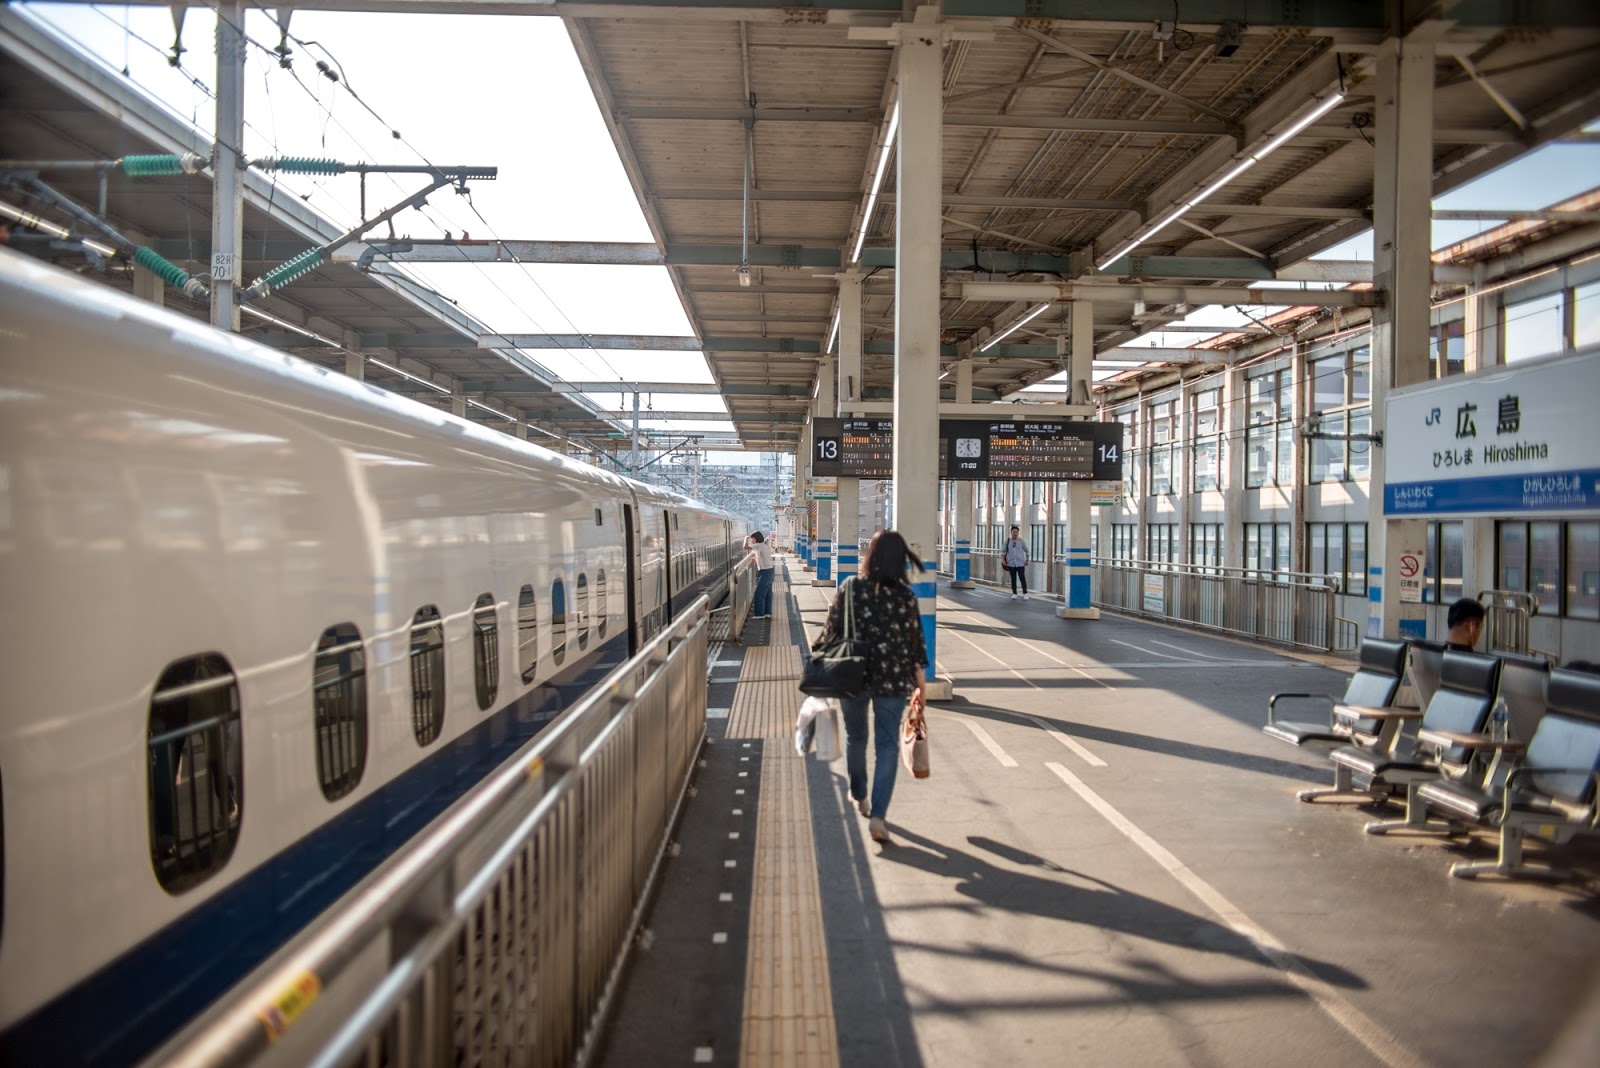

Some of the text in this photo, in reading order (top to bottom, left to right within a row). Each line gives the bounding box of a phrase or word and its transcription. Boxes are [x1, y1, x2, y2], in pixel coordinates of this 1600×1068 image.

[1425, 407, 1441, 426] JR
[1455, 394, 1521, 440] 広島
[817, 440, 838, 458] 13
[1098, 444, 1119, 463] 14
[1433, 440, 1549, 468] ひろしま Hiroshima
[1523, 475, 1581, 493] ひがしひろしま
